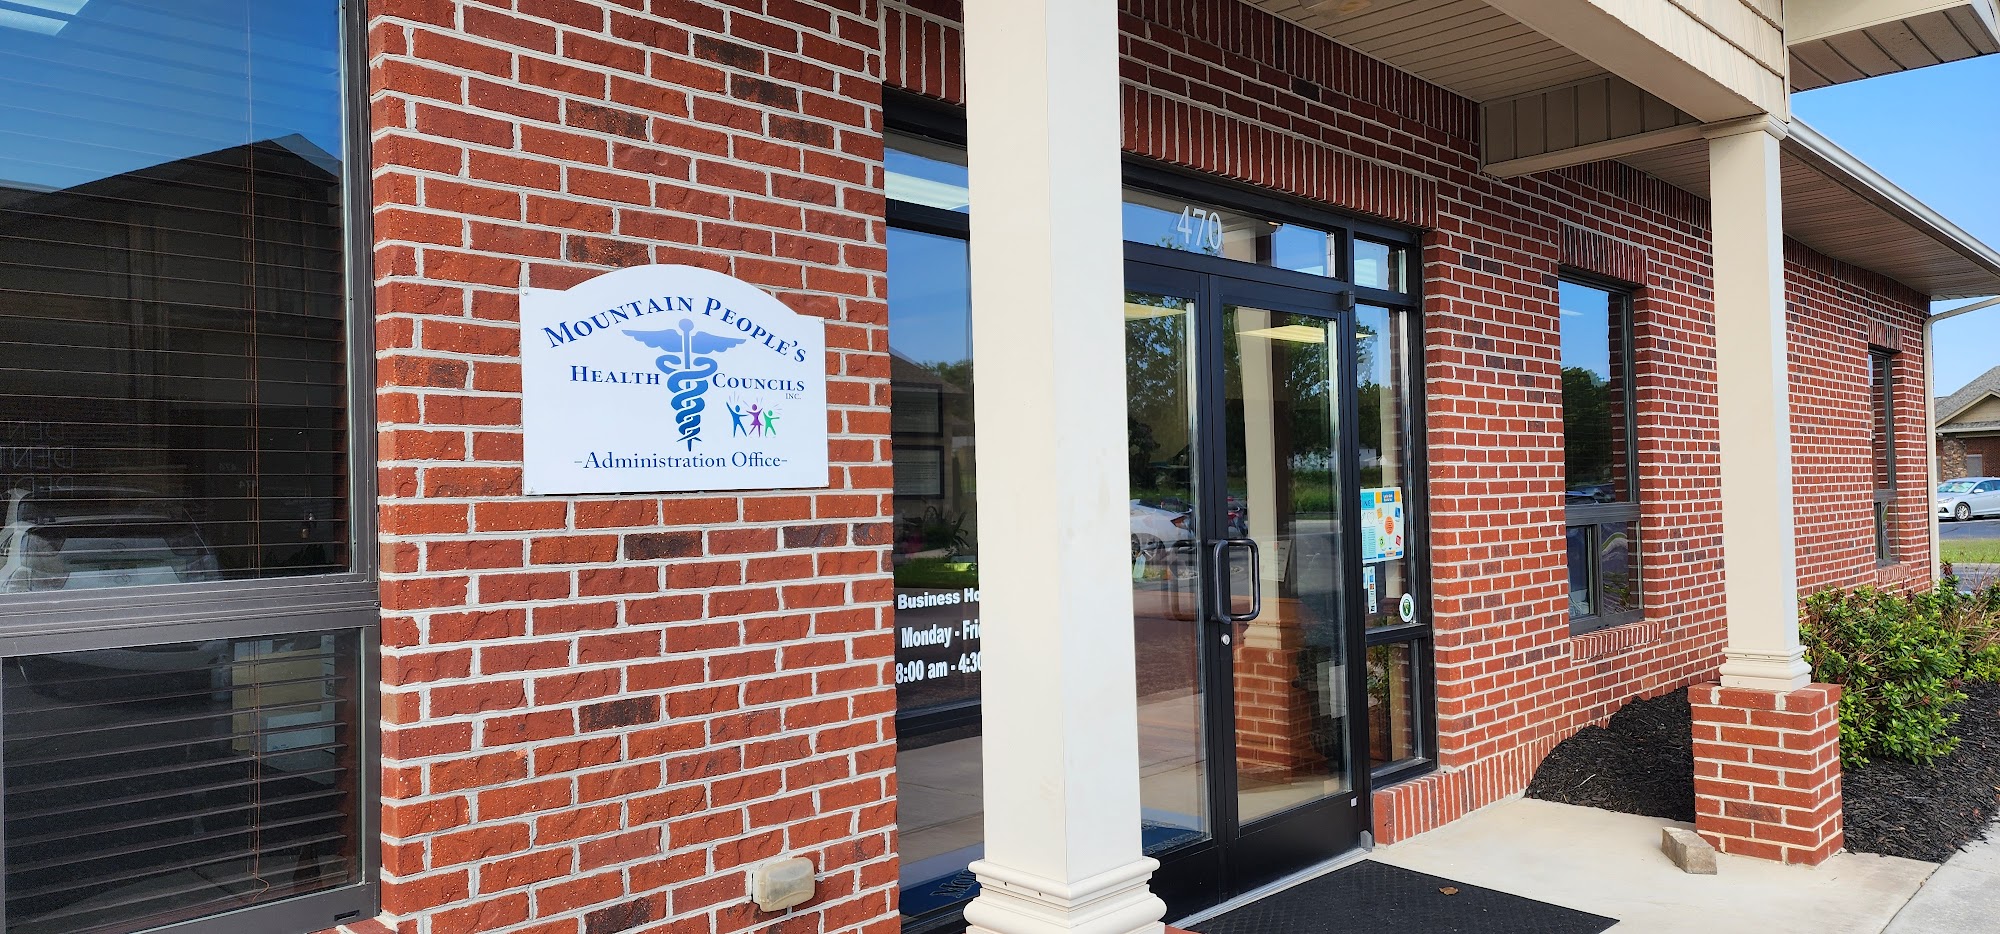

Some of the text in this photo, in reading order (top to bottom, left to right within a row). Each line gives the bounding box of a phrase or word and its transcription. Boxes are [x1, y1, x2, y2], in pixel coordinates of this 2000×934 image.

[1177, 205, 1222, 250] 470
[541, 296, 806, 362] MOUNTAIN PEOPLE'S
[570, 365, 805, 392] HEALTH COUNCILS
[785, 392, 802, 400] INC.
[898, 592, 960, 609] Business
[901, 624, 952, 648] Monday
[896, 659, 924, 684] 8:00
[927, 661, 947, 679] am
